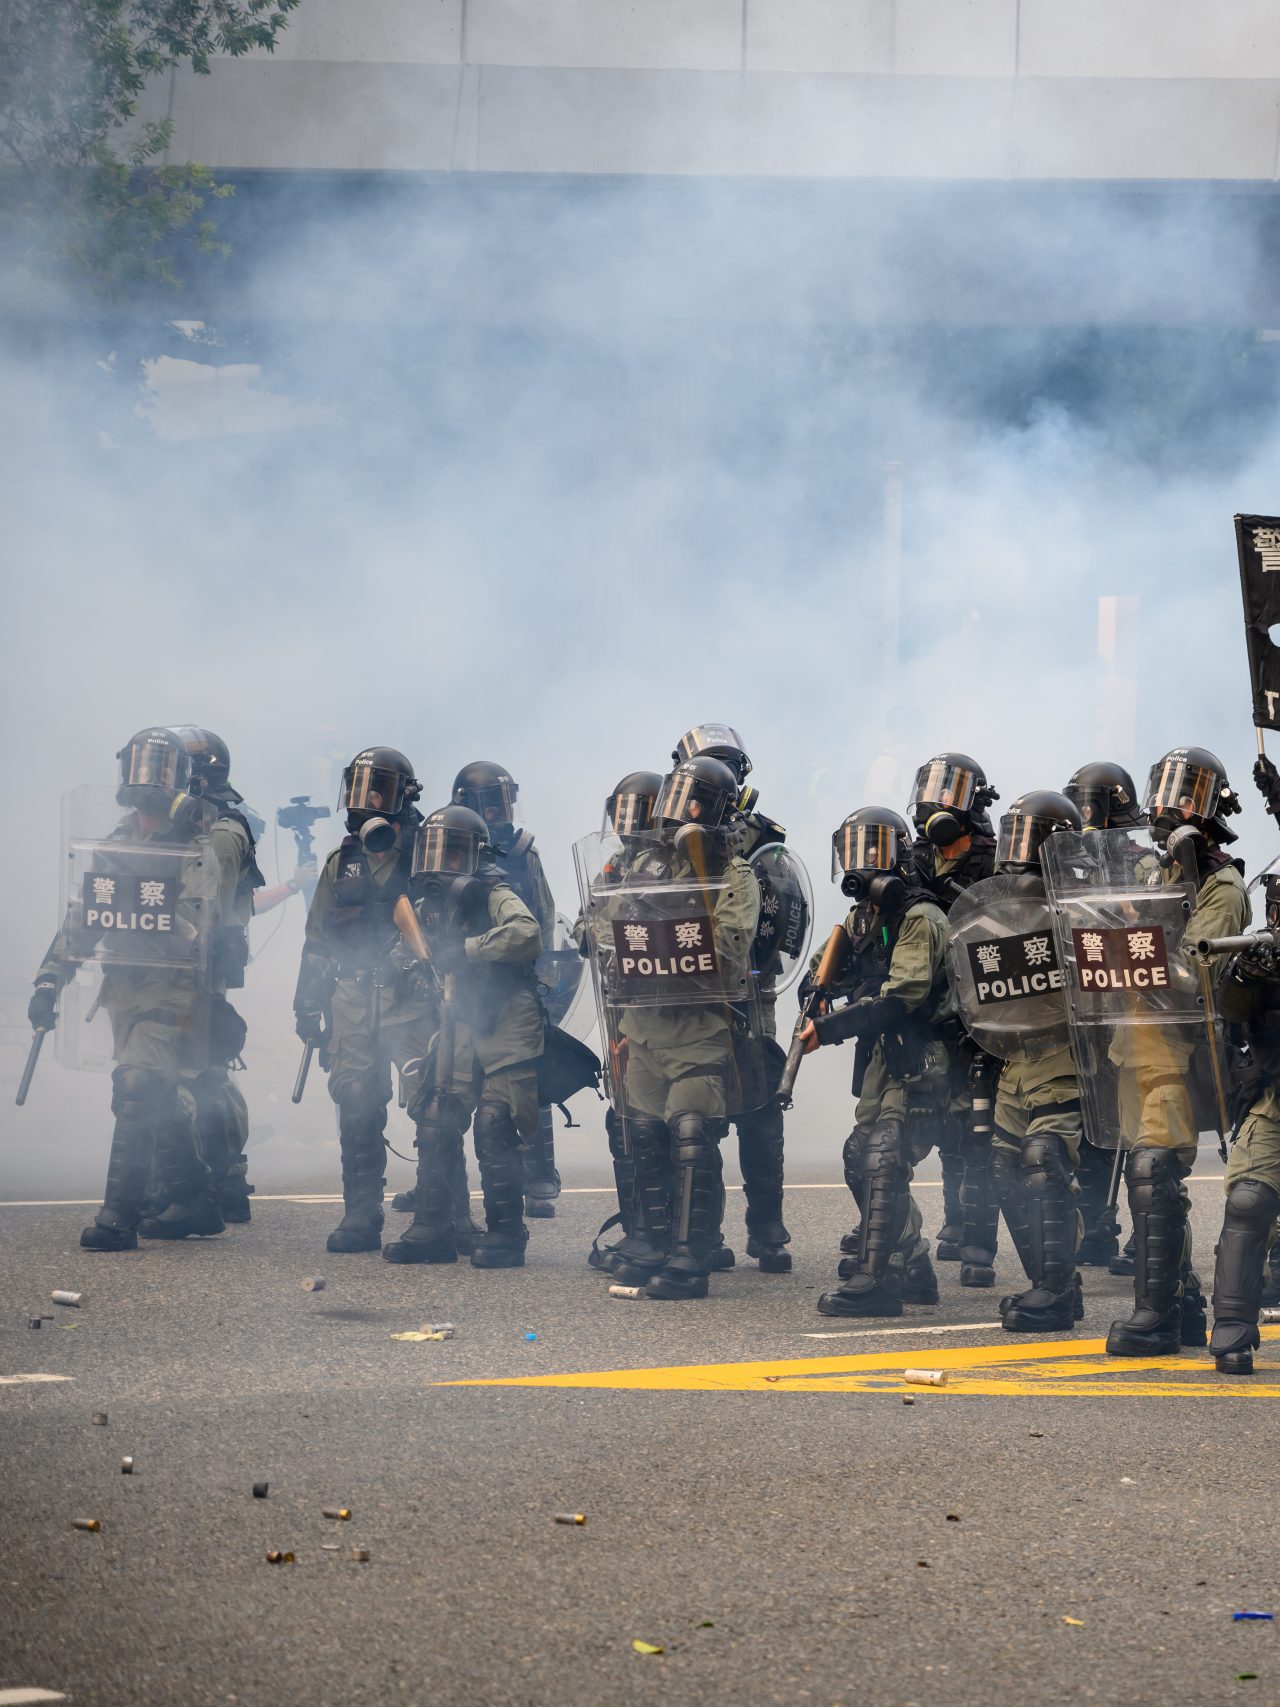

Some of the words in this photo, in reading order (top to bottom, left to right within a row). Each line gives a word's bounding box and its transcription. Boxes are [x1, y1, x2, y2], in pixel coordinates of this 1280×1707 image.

[93, 877, 165, 906] 警察
[87, 909, 171, 930] POLICE
[785, 900, 802, 948] POLICE
[623, 922, 703, 952] 警察
[1081, 931, 1156, 962] 警察
[622, 953, 714, 975] POLICE
[976, 936, 1052, 974] 警察
[977, 969, 1066, 1001] POLICE
[1082, 966, 1168, 988] POLICE
